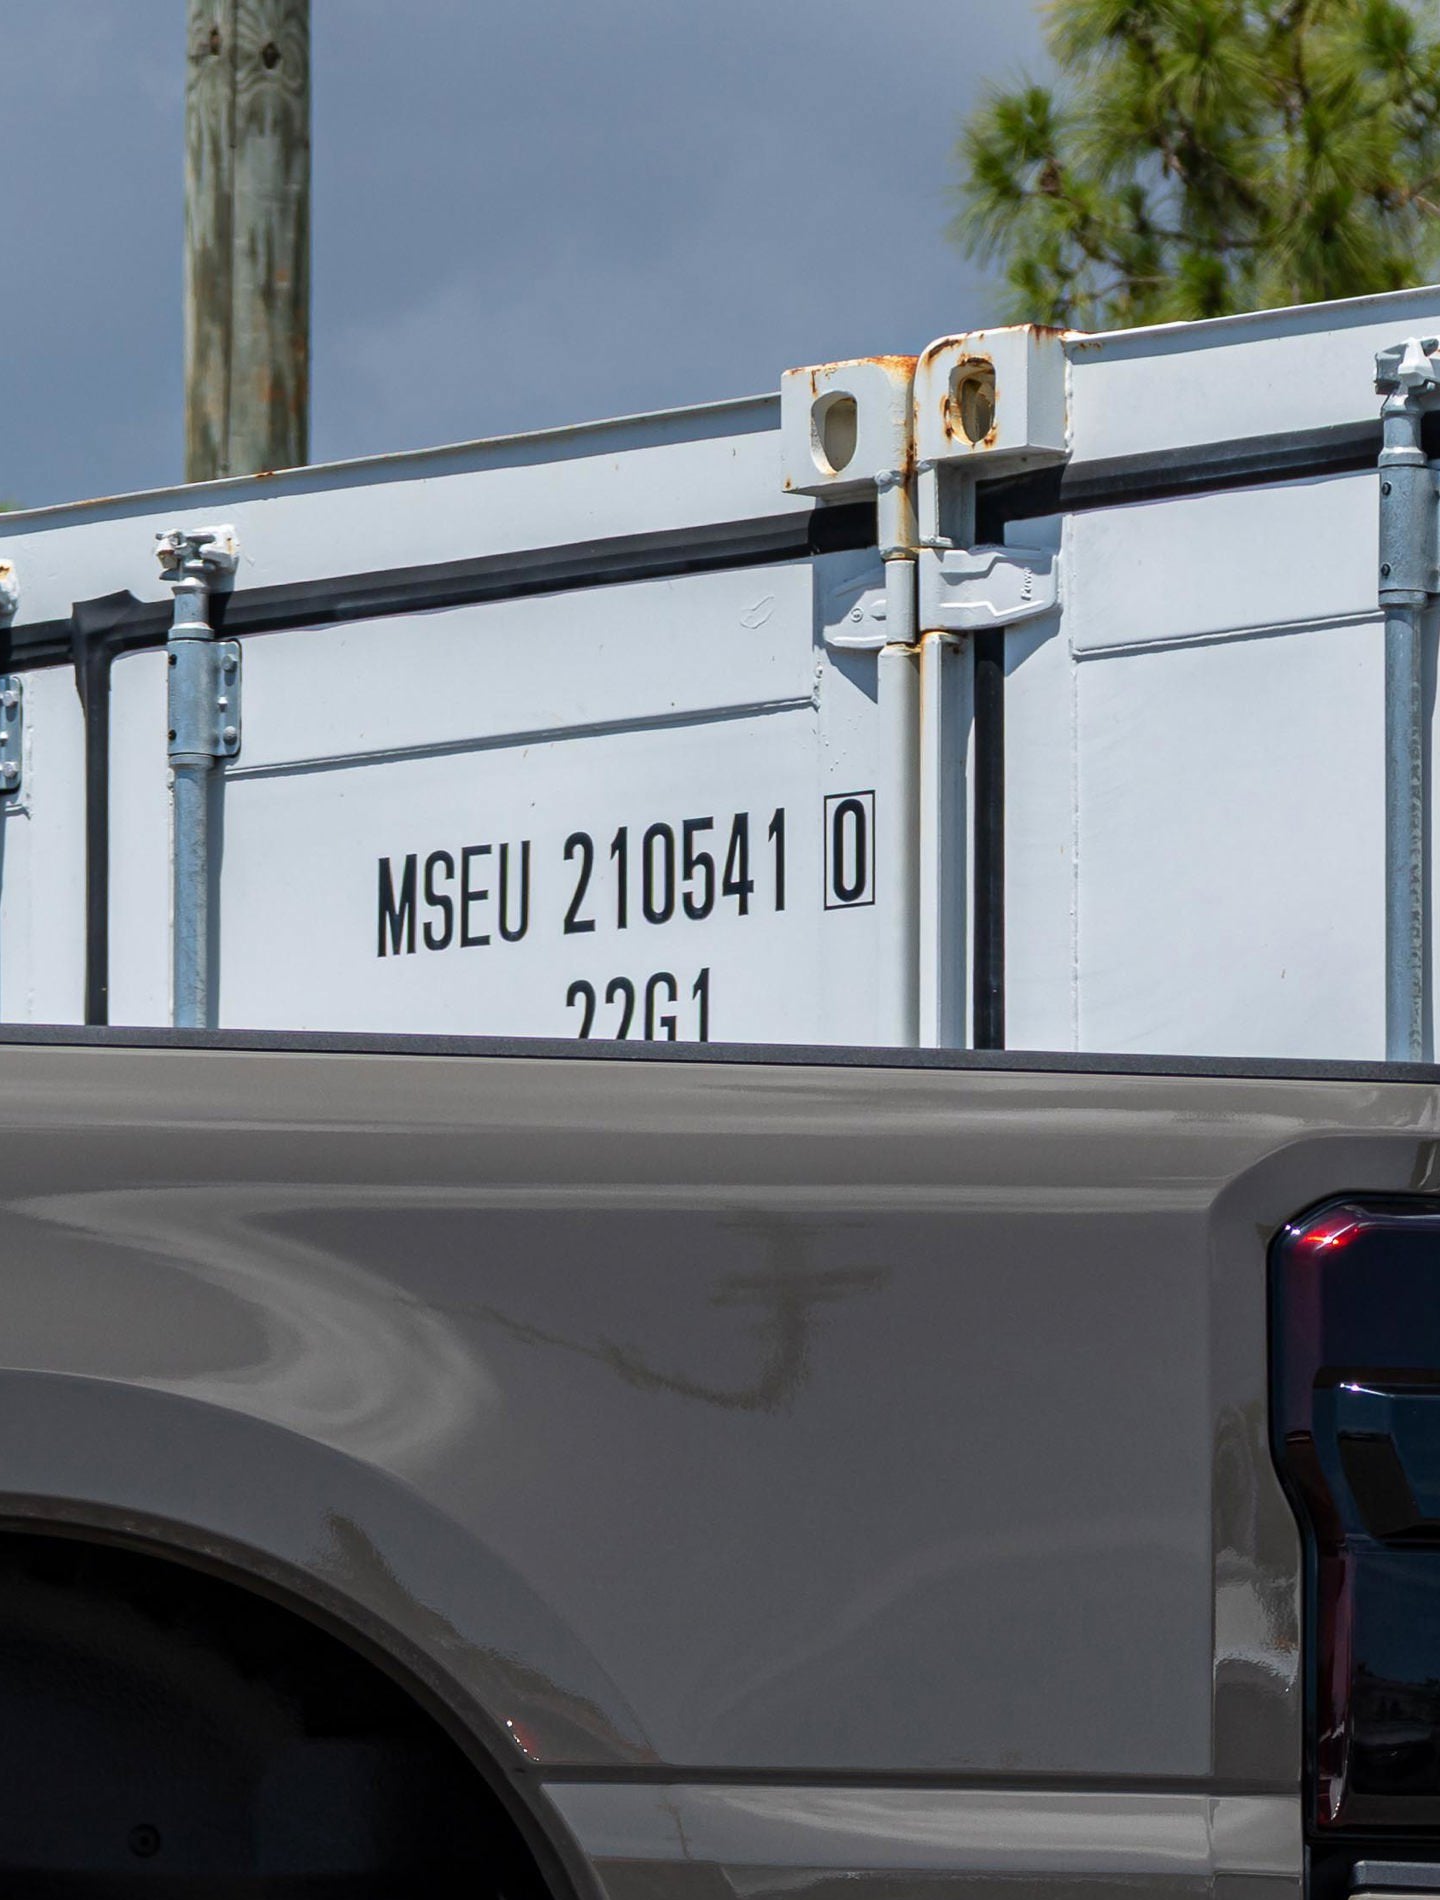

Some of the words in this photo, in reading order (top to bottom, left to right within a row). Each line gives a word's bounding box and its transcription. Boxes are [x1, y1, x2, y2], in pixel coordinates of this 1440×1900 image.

[377, 840, 531, 958] MSEU
[563, 807, 785, 935] 210541
[832, 798, 867, 903] 0
